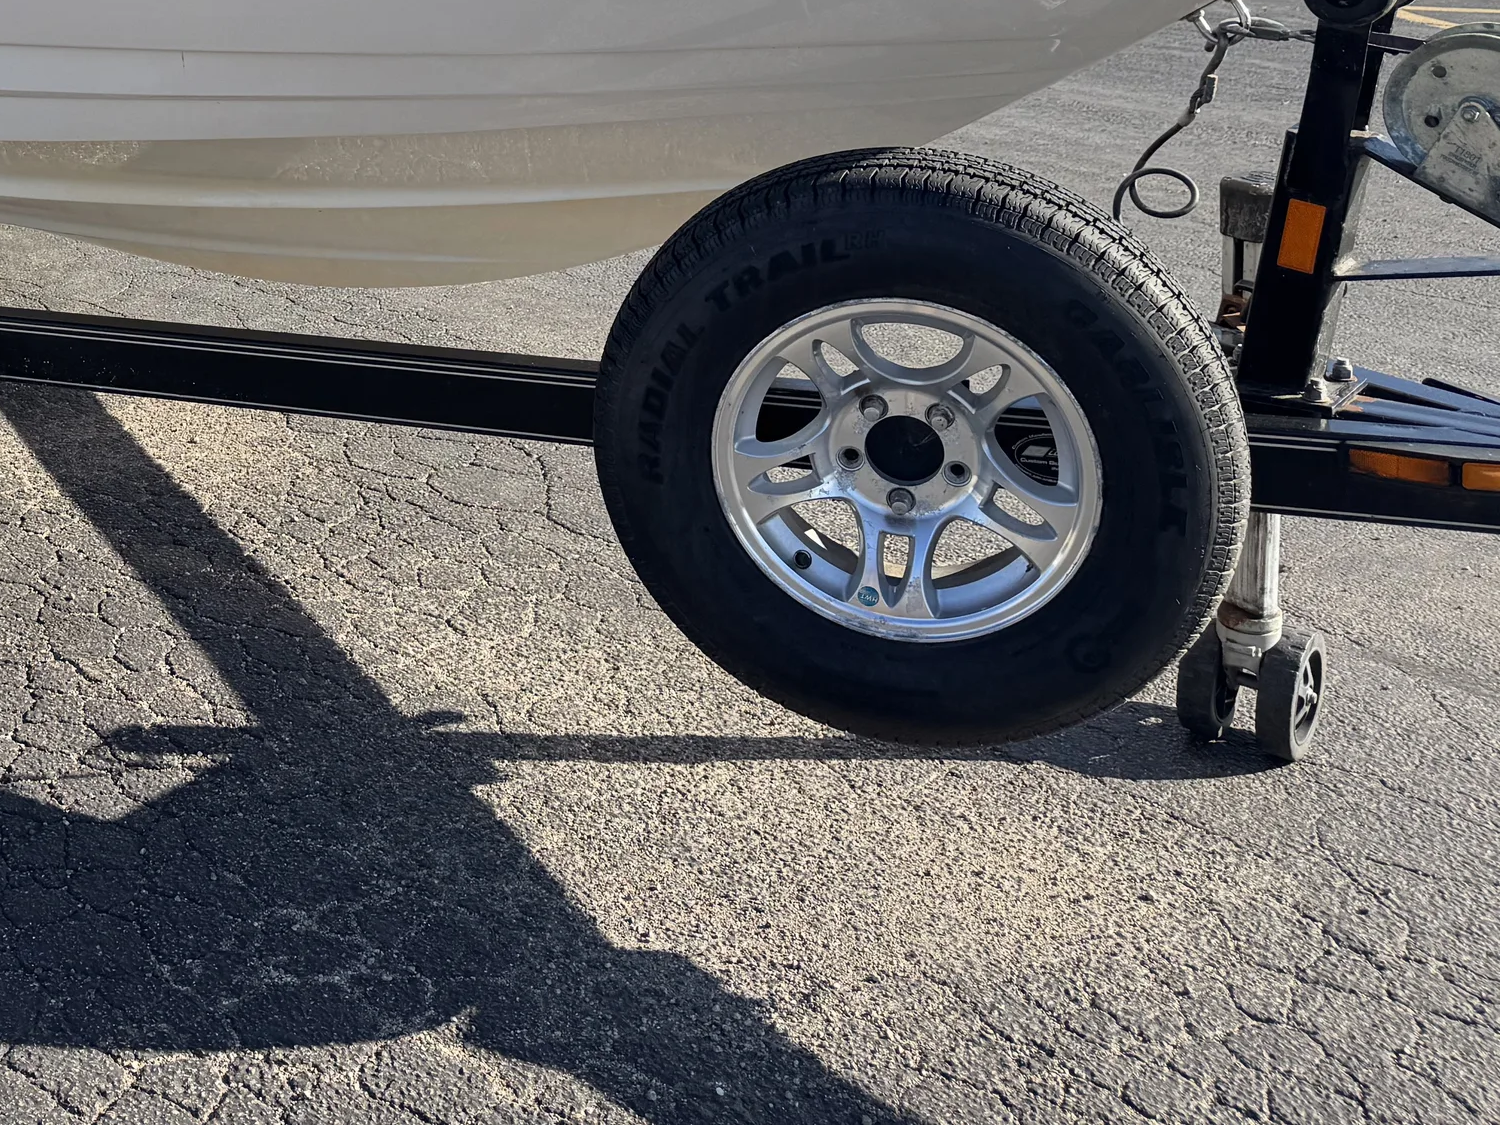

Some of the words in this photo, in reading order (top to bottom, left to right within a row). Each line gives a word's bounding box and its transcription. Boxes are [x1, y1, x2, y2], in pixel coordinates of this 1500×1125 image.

[637, 322, 705, 484] RADIAL
[705, 239, 850, 312] TRAIL
[1066, 299, 1188, 536] CARLISLE
